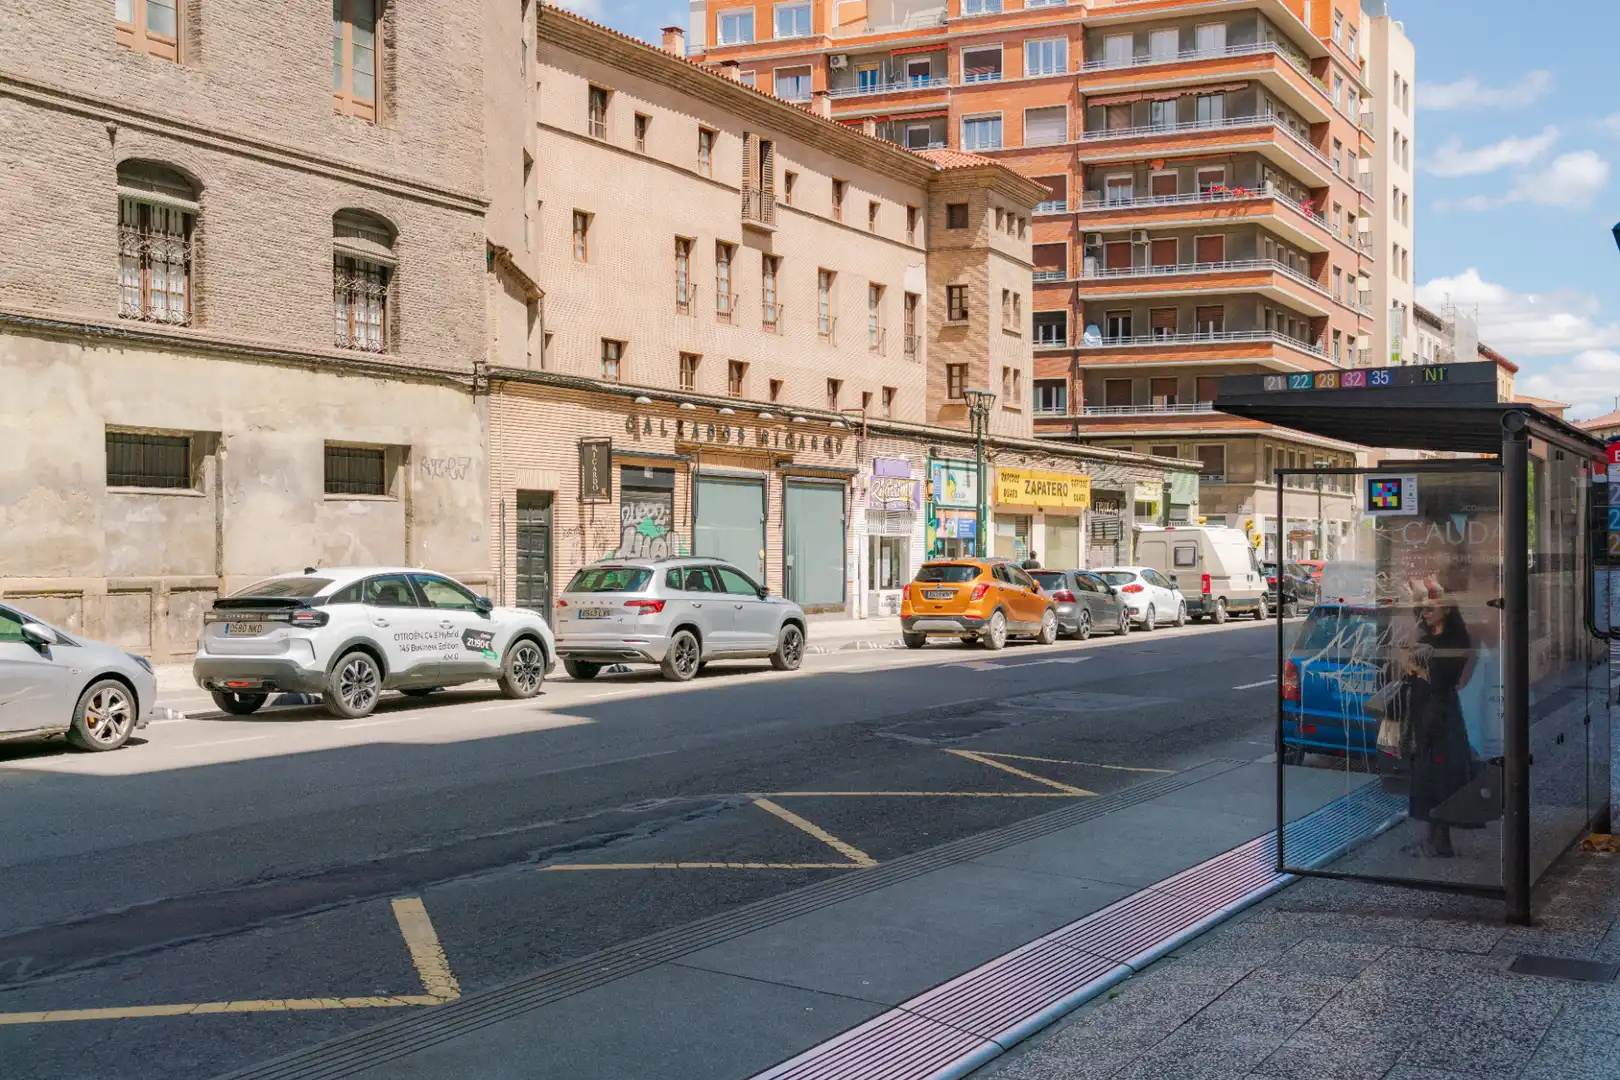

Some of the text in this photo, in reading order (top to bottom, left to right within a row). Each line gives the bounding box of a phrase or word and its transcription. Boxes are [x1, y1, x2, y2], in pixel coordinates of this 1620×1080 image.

[1267, 367, 1444, 390] 21 22 28 32 35 N1
[761, 428, 843, 456] RICARDO
[591, 444, 599, 491] RICARDO
[1024, 479, 1069, 497] ZAPATERO
[229, 624, 247, 633] 0580
[439, 630, 459, 640] Hybrid
[410, 643, 437, 652] Business
[438, 642, 459, 650] Edition
